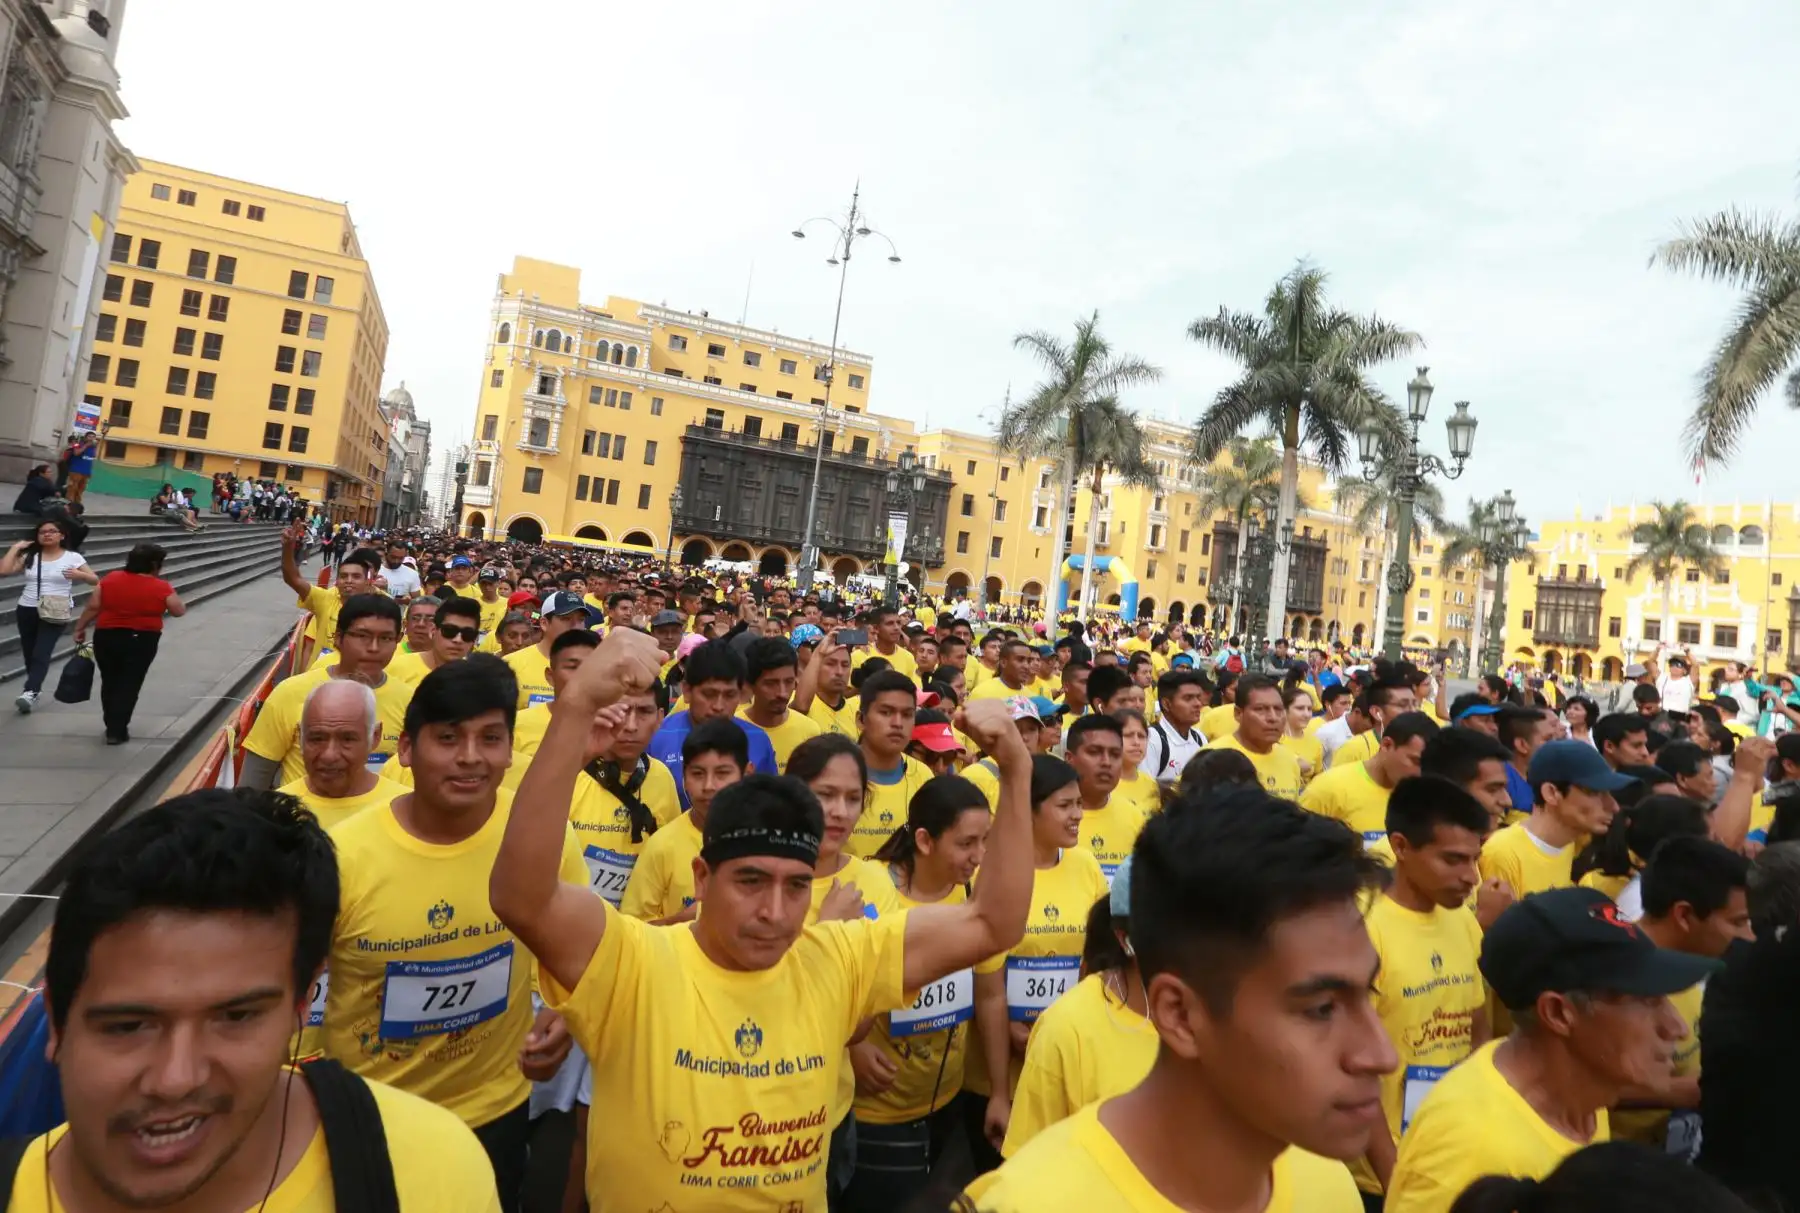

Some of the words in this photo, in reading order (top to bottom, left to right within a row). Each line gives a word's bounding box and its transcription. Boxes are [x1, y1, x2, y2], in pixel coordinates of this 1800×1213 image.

[853, 826, 897, 836] unicipalidad
[357, 929, 459, 952] Municipalidad
[463, 925, 481, 938] de
[485, 921, 509, 934] Lim
[1024, 924, 1065, 935] icipalidad
[421, 960, 474, 973] Municipalidad
[475, 958, 484, 966] de
[421, 979, 477, 1012] 727
[1025, 978, 1066, 997] 3614
[674, 1048, 770, 1078] Municipadad
[775, 1056, 794, 1076] de
[796, 1053, 826, 1073] Lim
[680, 1172, 713, 1188] LIMA
[762, 1172, 791, 1187] CON
